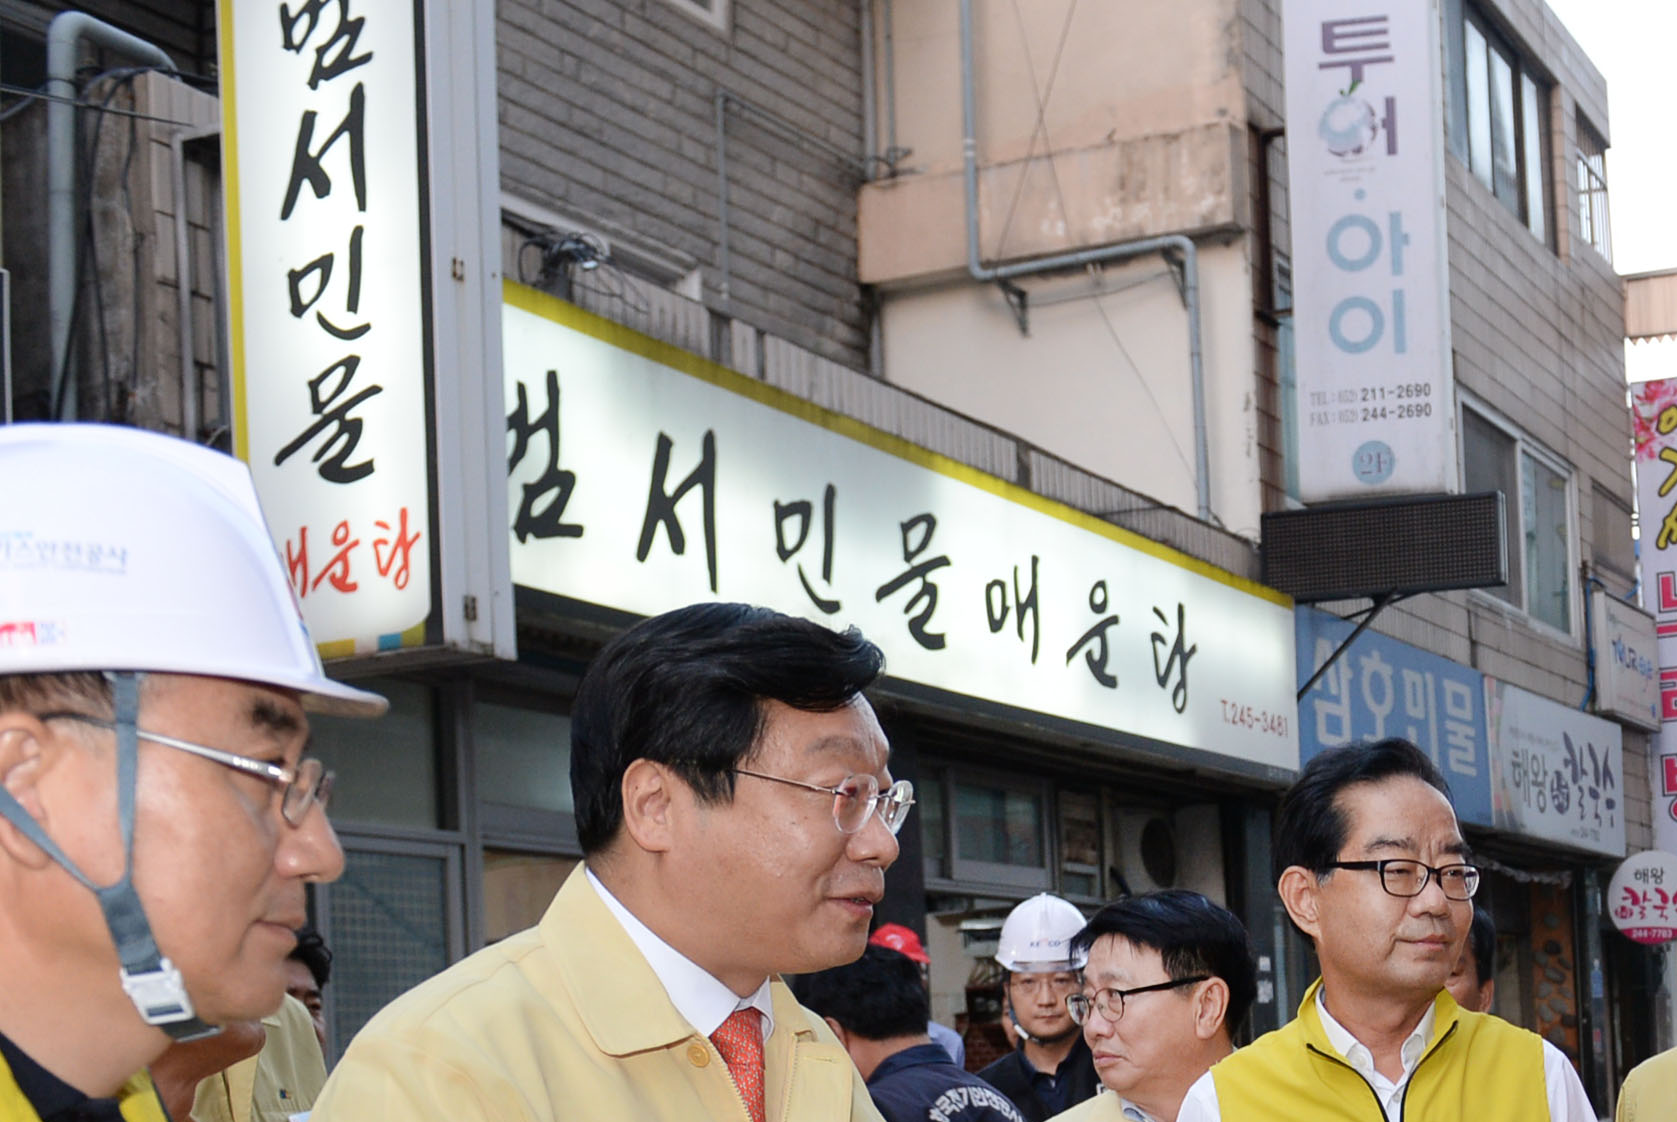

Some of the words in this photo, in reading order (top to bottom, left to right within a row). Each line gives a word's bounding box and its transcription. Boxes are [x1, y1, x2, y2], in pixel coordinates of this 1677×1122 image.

[1361, 382, 1431, 402] 211-2690
[1362, 402, 1432, 422] 244-2690
[1633, 867, 1664, 885] 해왕
